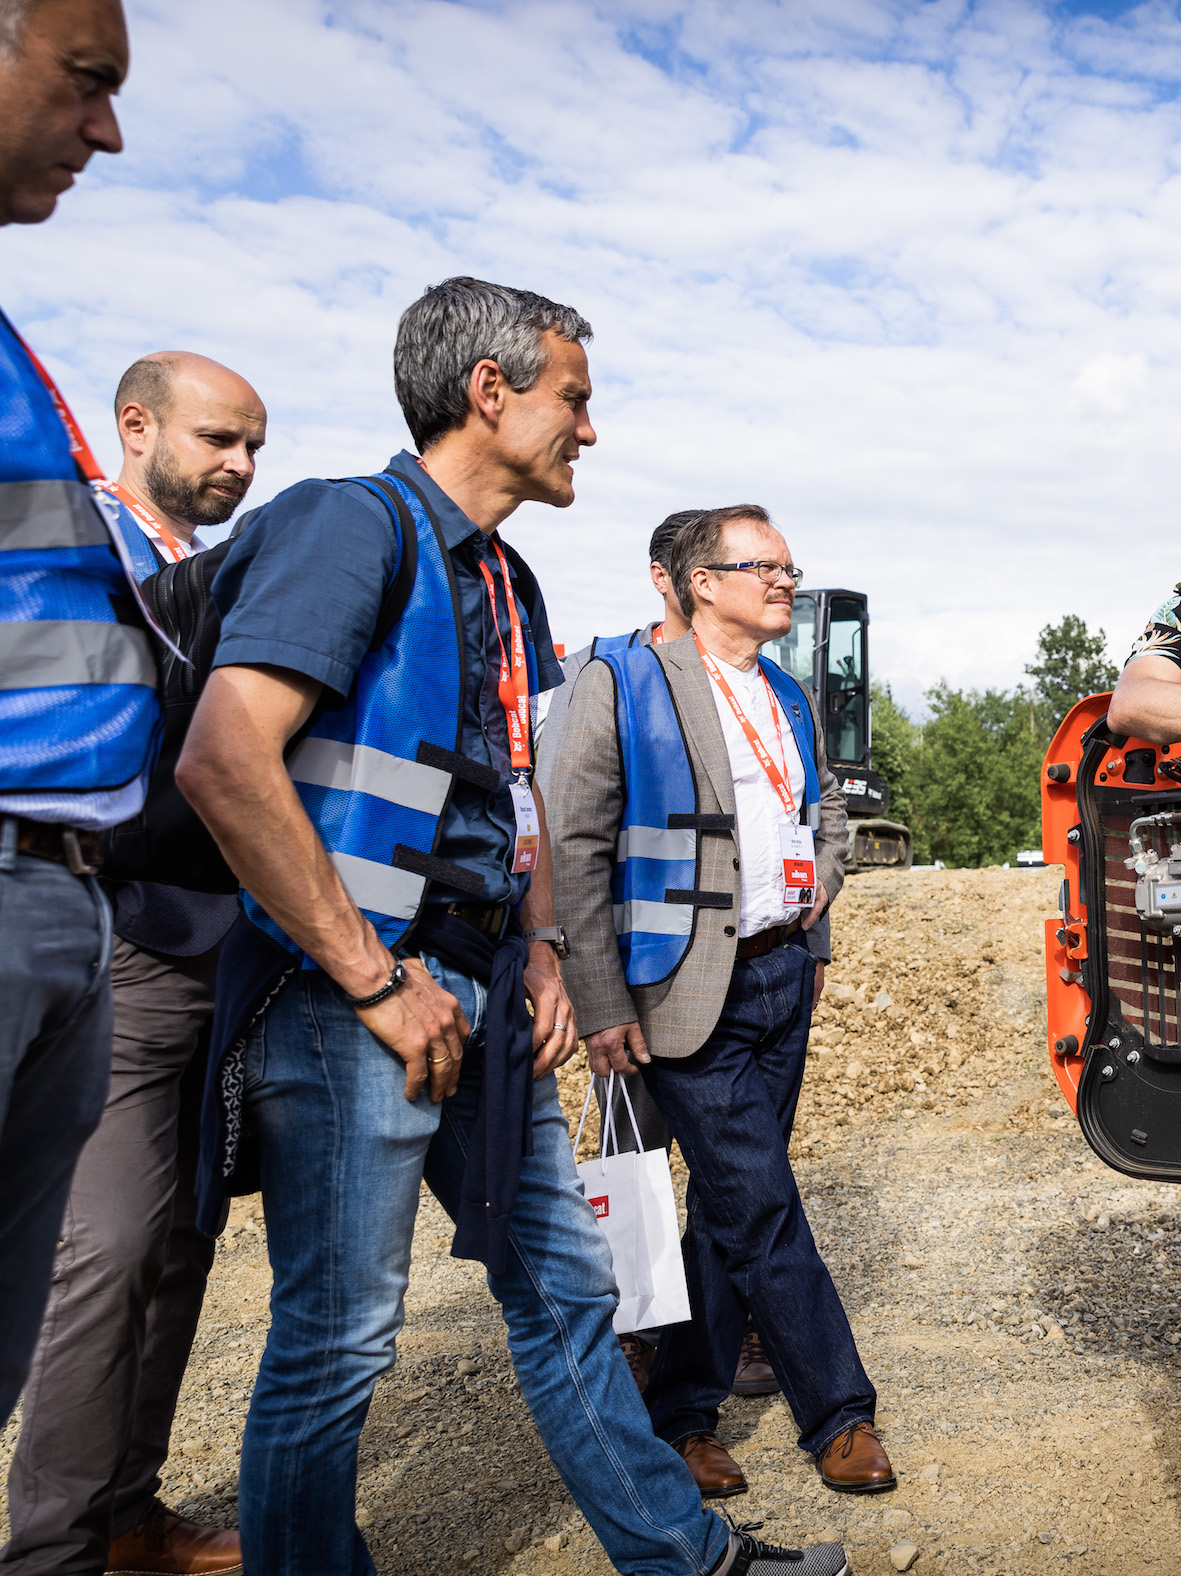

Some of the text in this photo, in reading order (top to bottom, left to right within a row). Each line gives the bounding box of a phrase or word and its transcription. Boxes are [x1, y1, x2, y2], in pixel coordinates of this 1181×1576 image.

[132, 503, 156, 522] Bobcat
[513, 624, 524, 654] Bobcat
[700, 653, 718, 673] Bobcat
[727, 695, 743, 715] Bobcat
[508, 709, 523, 739] Bobcat
[752, 738, 768, 759] Bobcat
[776, 782, 792, 803] Bobcat
